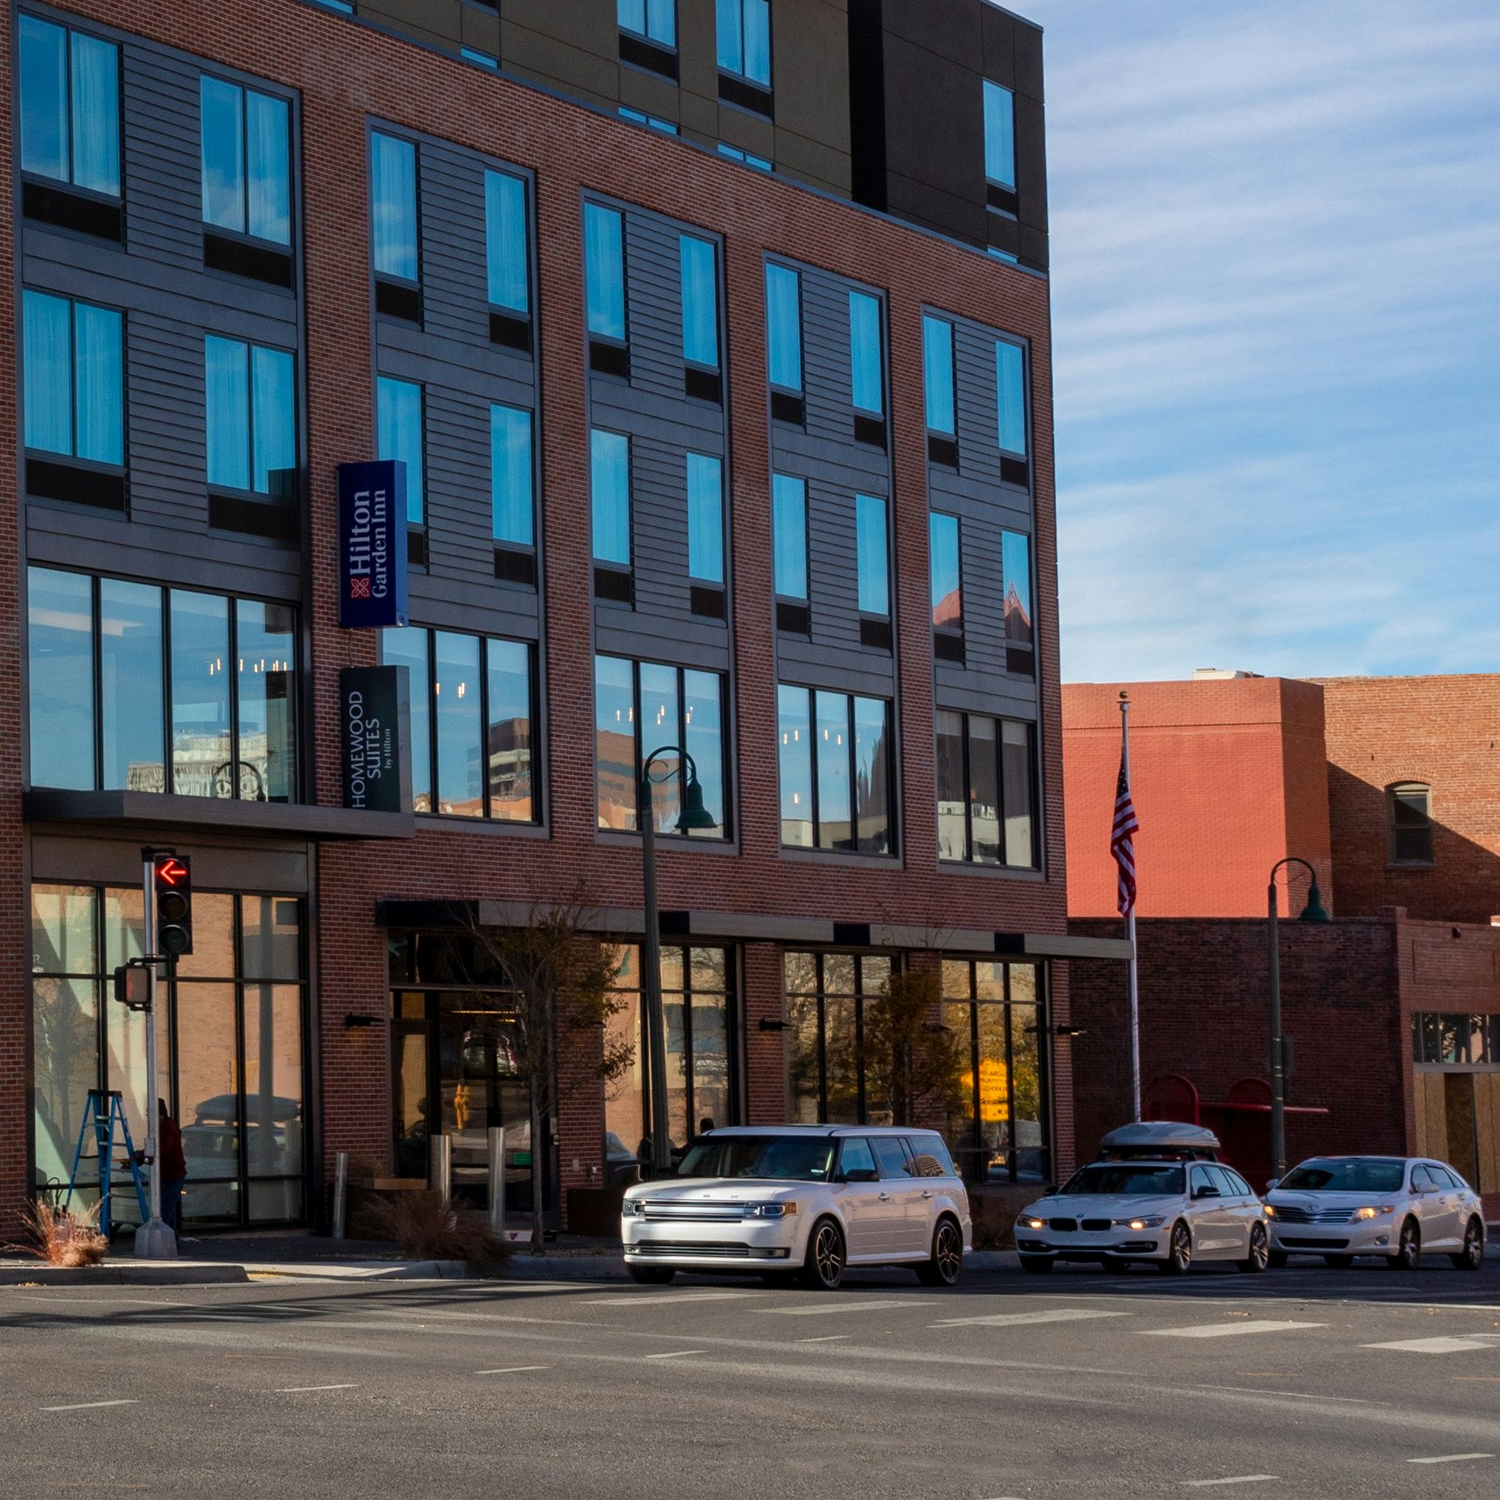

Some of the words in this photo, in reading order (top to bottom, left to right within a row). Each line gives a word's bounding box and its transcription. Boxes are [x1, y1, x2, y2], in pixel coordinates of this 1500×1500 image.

[349, 490, 371, 575] Hilton
[371, 489, 386, 524] Inn
[372, 526, 387, 598] Garden
[349, 691, 365, 808] HOMEWOOD
[365, 718, 381, 779] SUITES
[384, 758, 393, 769] by
